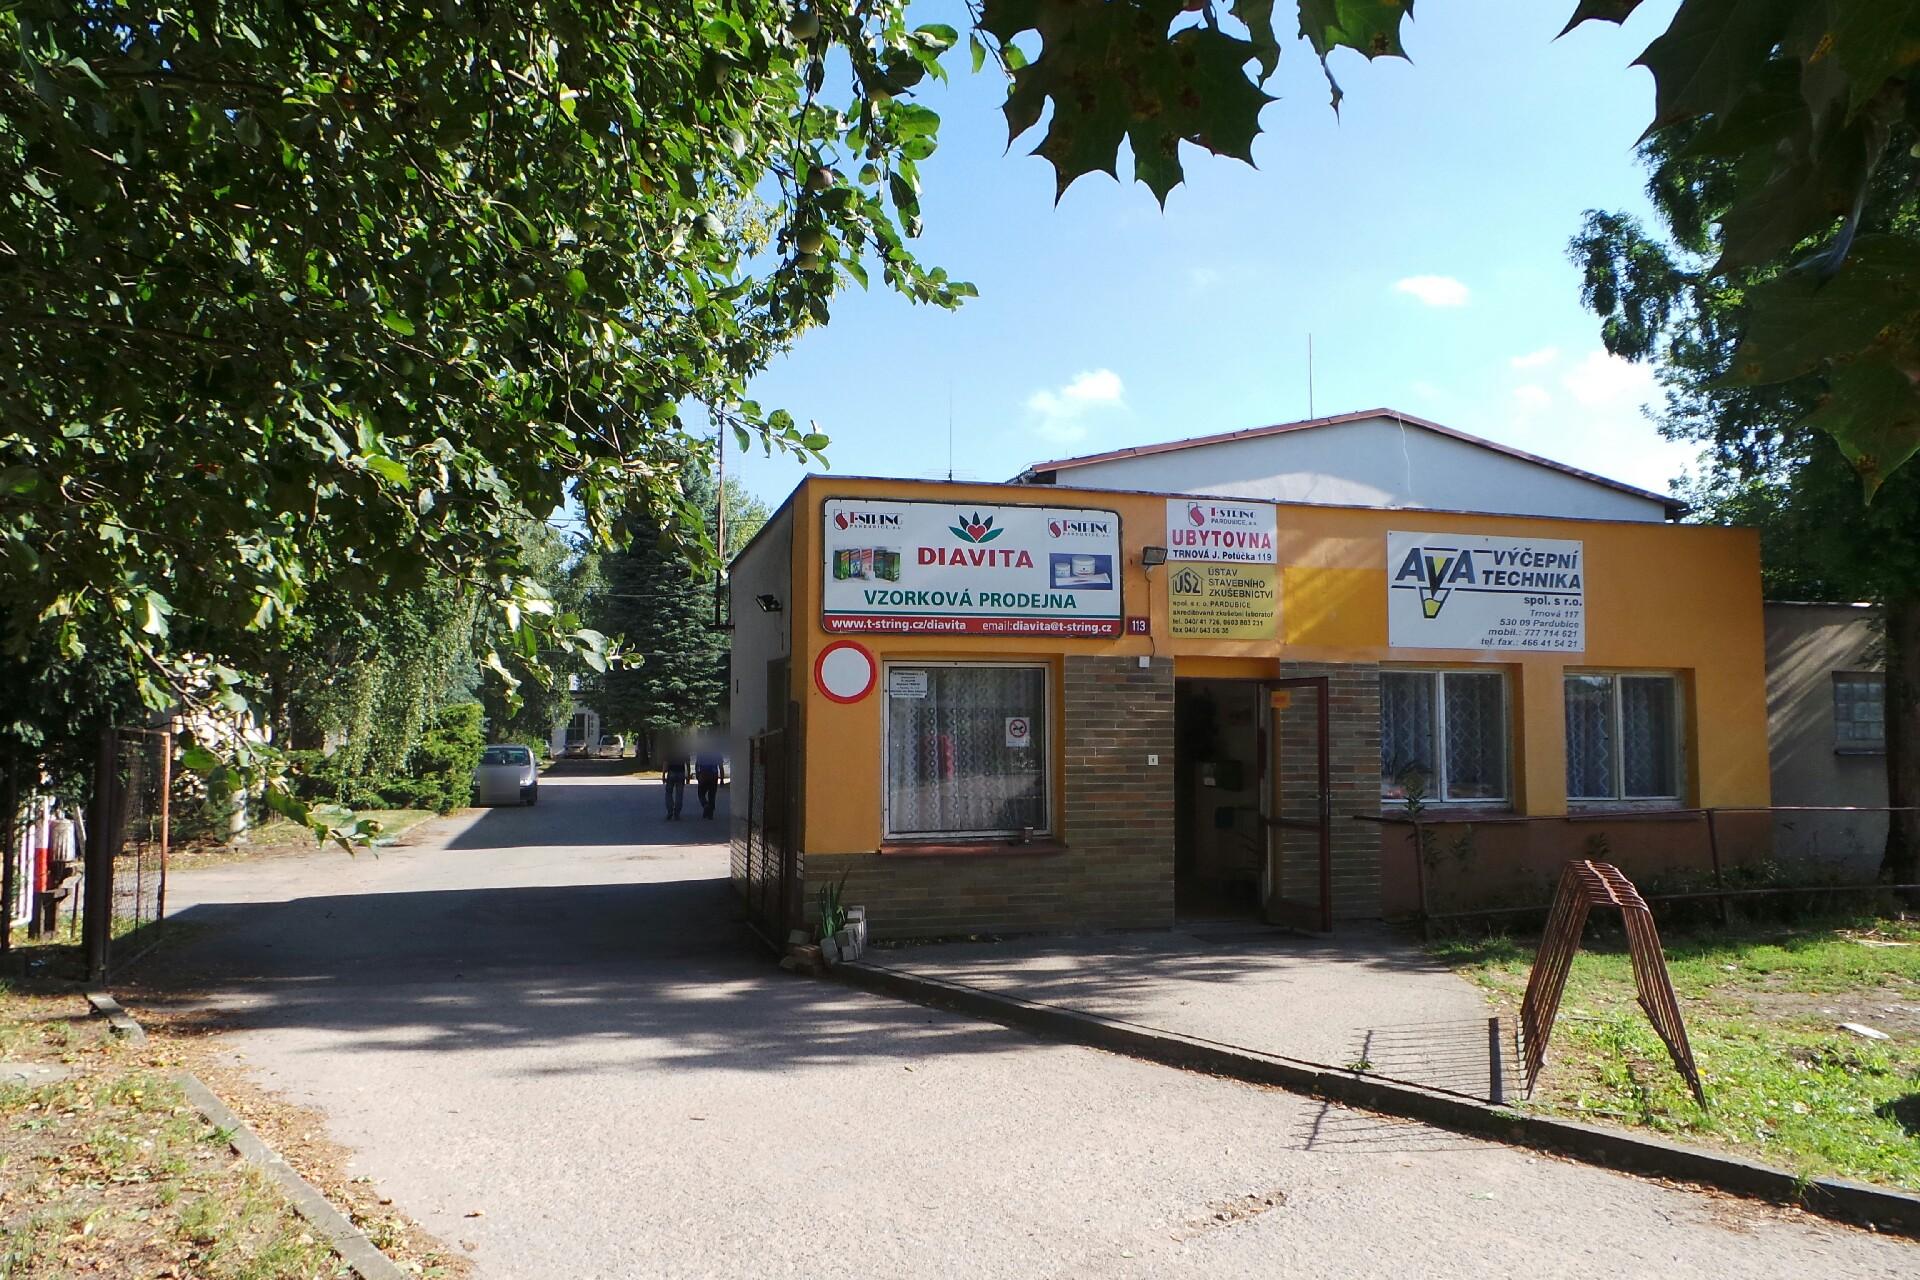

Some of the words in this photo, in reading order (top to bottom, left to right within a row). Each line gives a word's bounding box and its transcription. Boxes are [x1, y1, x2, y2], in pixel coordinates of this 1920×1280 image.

[1172, 529, 1272, 549] UBYTOVNA
[917, 547, 1034, 569] DIAVITA
[1173, 548, 1209, 558] TRNOVÁ
[1212, 551, 1220, 560] J.
[1258, 553, 1272, 561] 119
[1493, 547, 1579, 569] VÝČEPNÍ
[1395, 547, 1476, 598] AVA
[1208, 577, 1265, 589] STAVEBNÍHO
[1482, 570, 1581, 589] TECHNIKA
[864, 589, 973, 607] VZORKOVÁ
[979, 591, 1077, 609] PRODEJNA
[1209, 587, 1273, 599] ZKUŠEBNICTVÍ
[1524, 596, 1551, 606] spol.
[1564, 598, 1583, 607] r.o.
[831, 617, 966, 631] www.t-string.cz/diavita
[982, 619, 1112, 634] email:diavita@t-string.cz
[1132, 620, 1146, 632] 113
[1500, 618, 1517, 626] 530
[1533, 619, 1579, 628] Pardubice
[1525, 629, 1541, 637] 777
[1481, 638, 1495, 646] tel.
[1554, 639, 1565, 647] 54
[1568, 640, 1578, 648] 21
